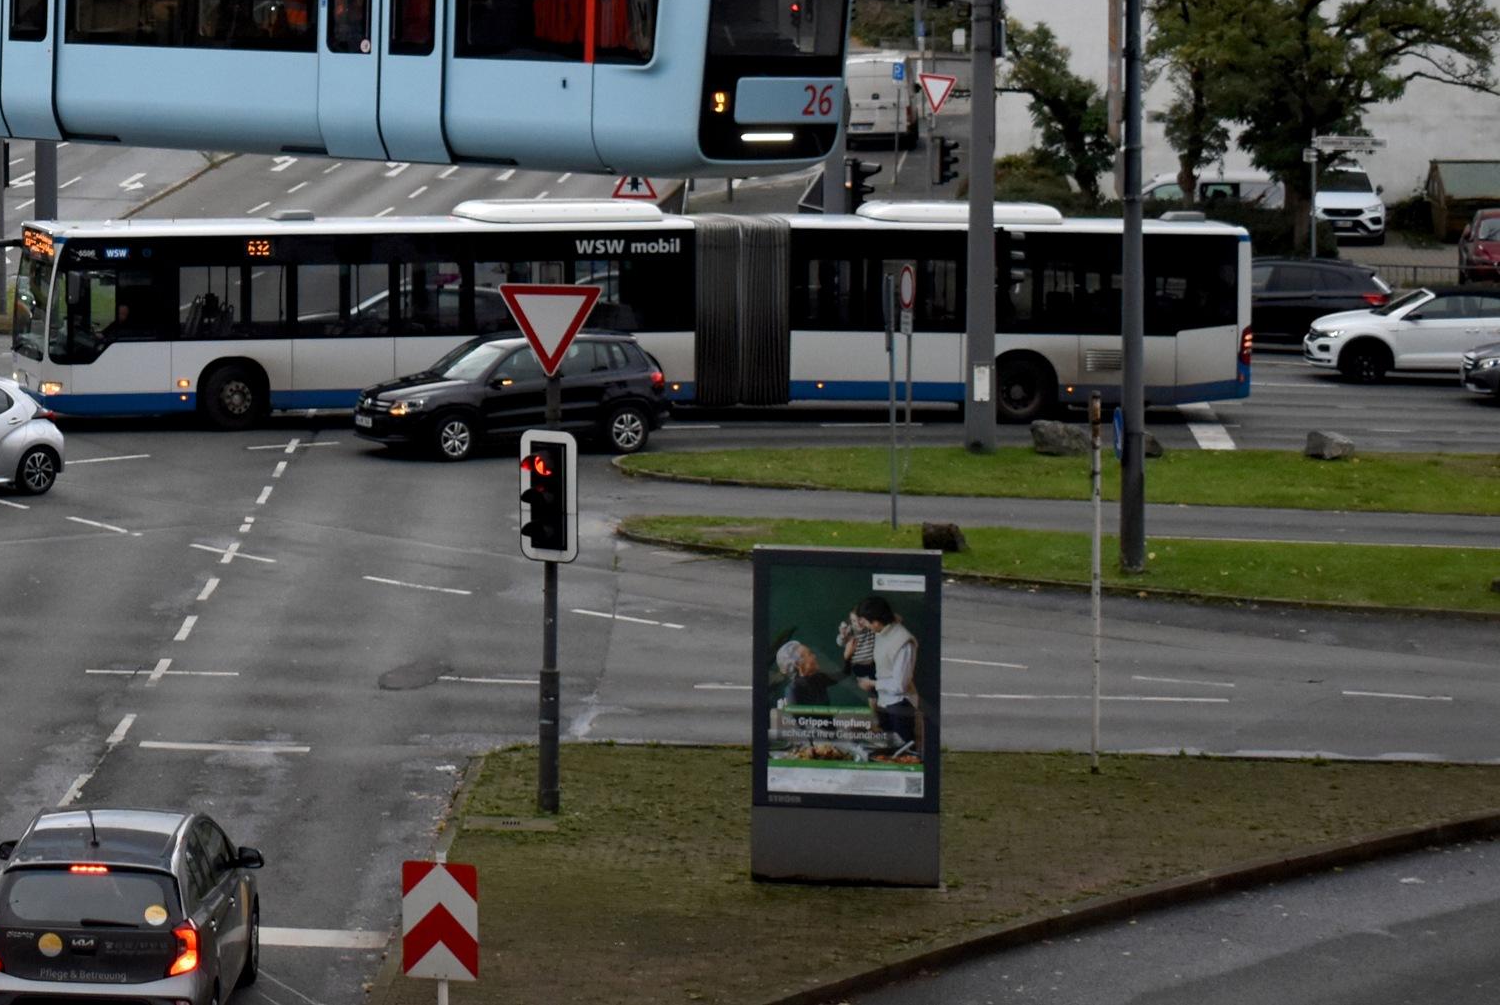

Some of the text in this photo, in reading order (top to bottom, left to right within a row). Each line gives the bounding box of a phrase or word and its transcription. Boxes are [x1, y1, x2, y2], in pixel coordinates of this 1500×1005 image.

[802, 84, 833, 115] 26
[575, 237, 680, 254] WSW mobil
[106, 248, 128, 258] WSW
[798, 717, 871, 730] Grippe-Impfung
[40, 969, 68, 981] Pflege
[79, 970, 127, 983] Betreuung
